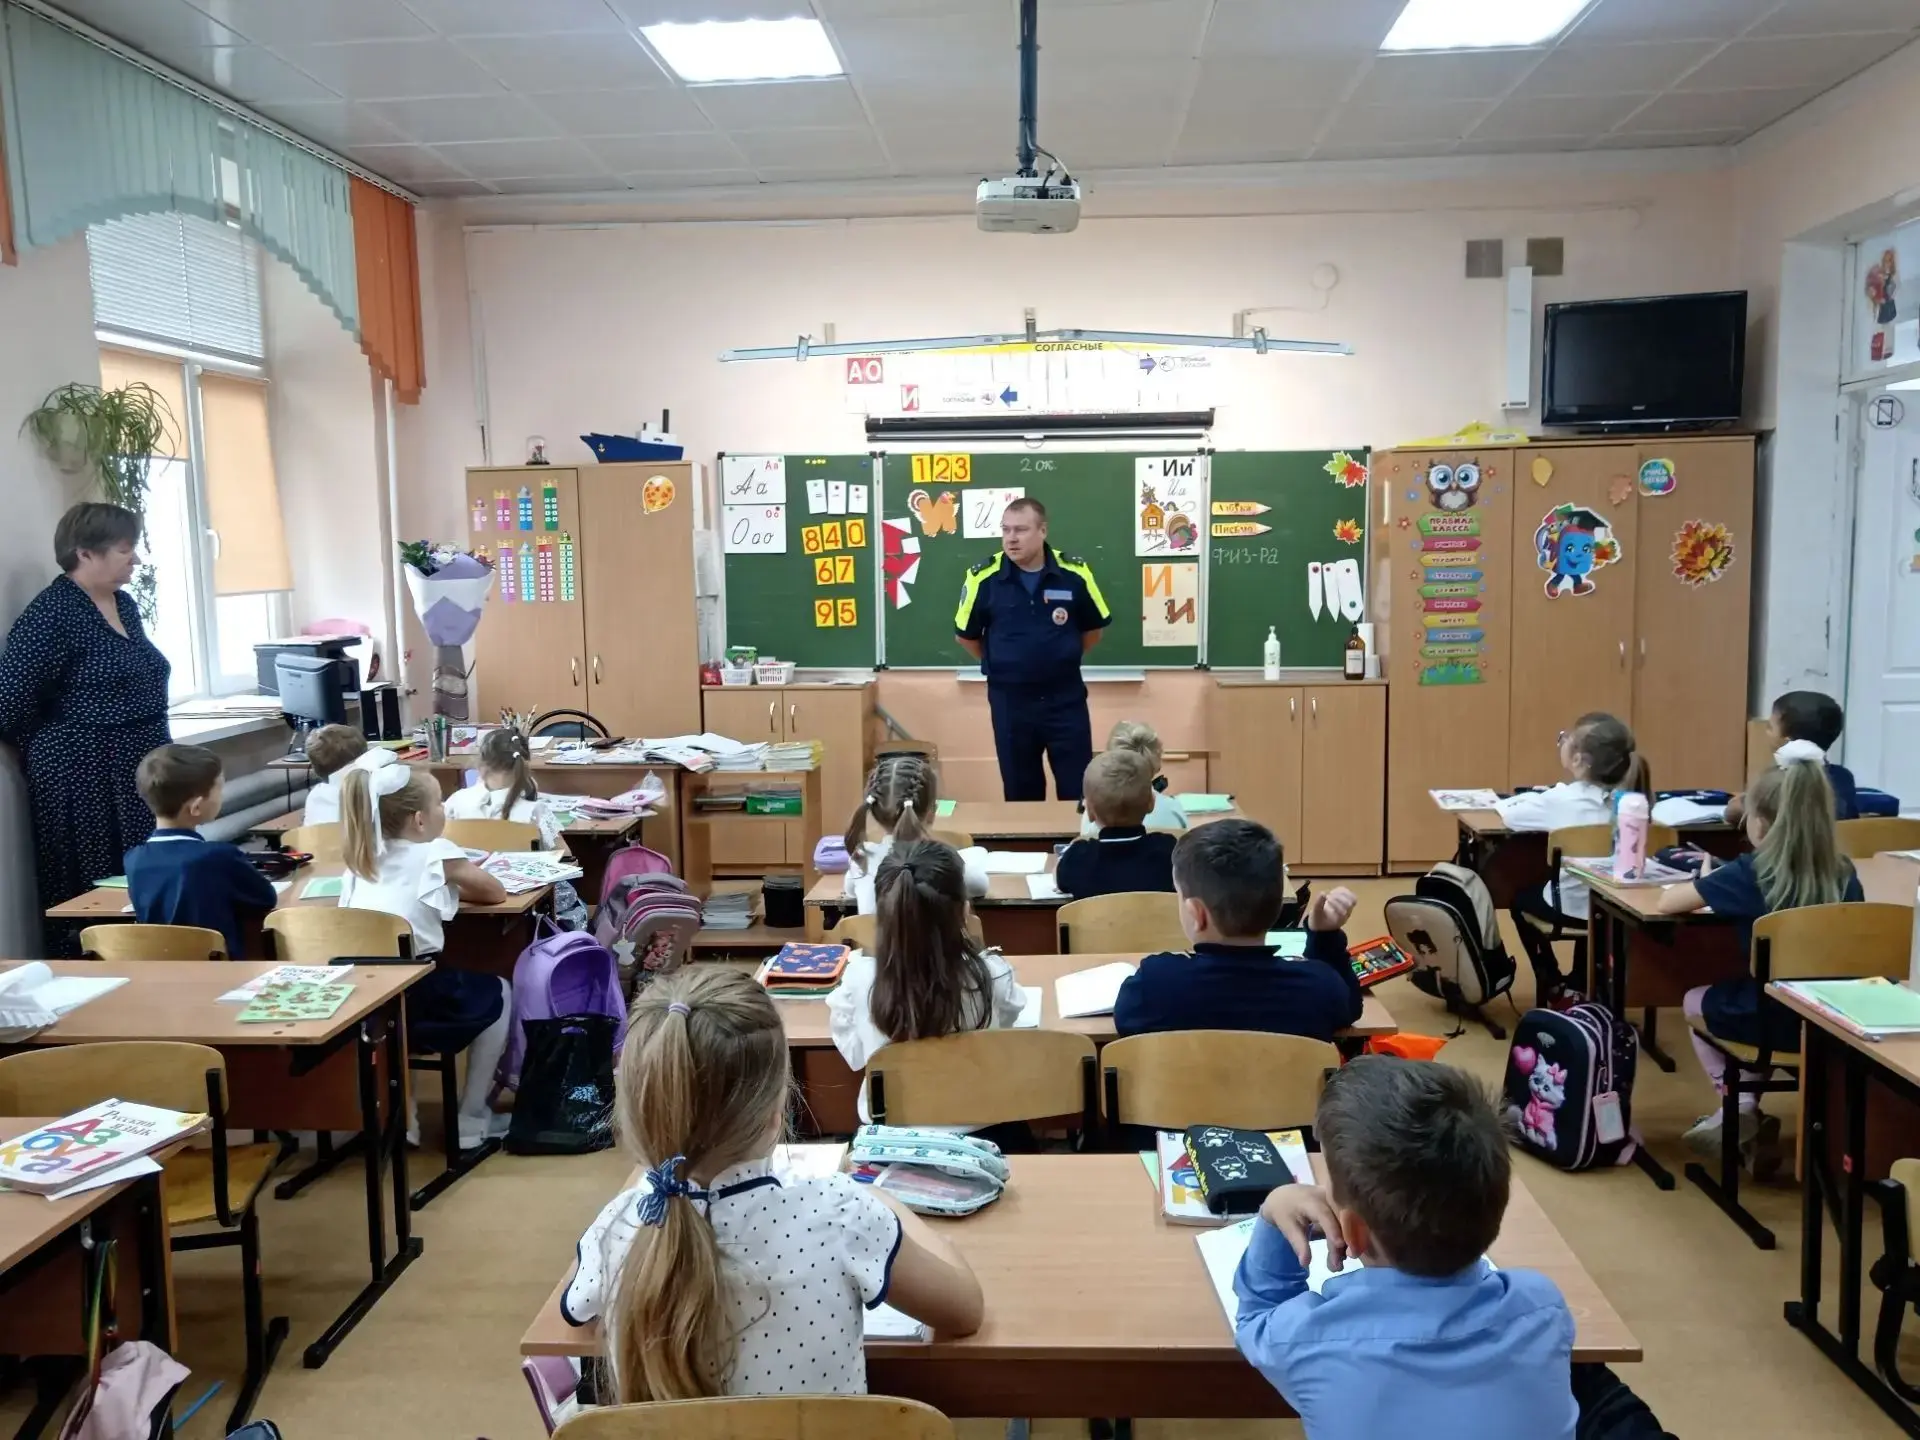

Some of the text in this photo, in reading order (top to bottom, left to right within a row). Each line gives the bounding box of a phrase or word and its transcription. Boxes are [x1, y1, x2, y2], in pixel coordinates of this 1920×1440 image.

[1035, 343, 1103, 352] СОГЛАСНЫЕ
[1429, 517, 1474, 525] ПРАВИЛА
[100, 1110, 157, 1128] Русский
